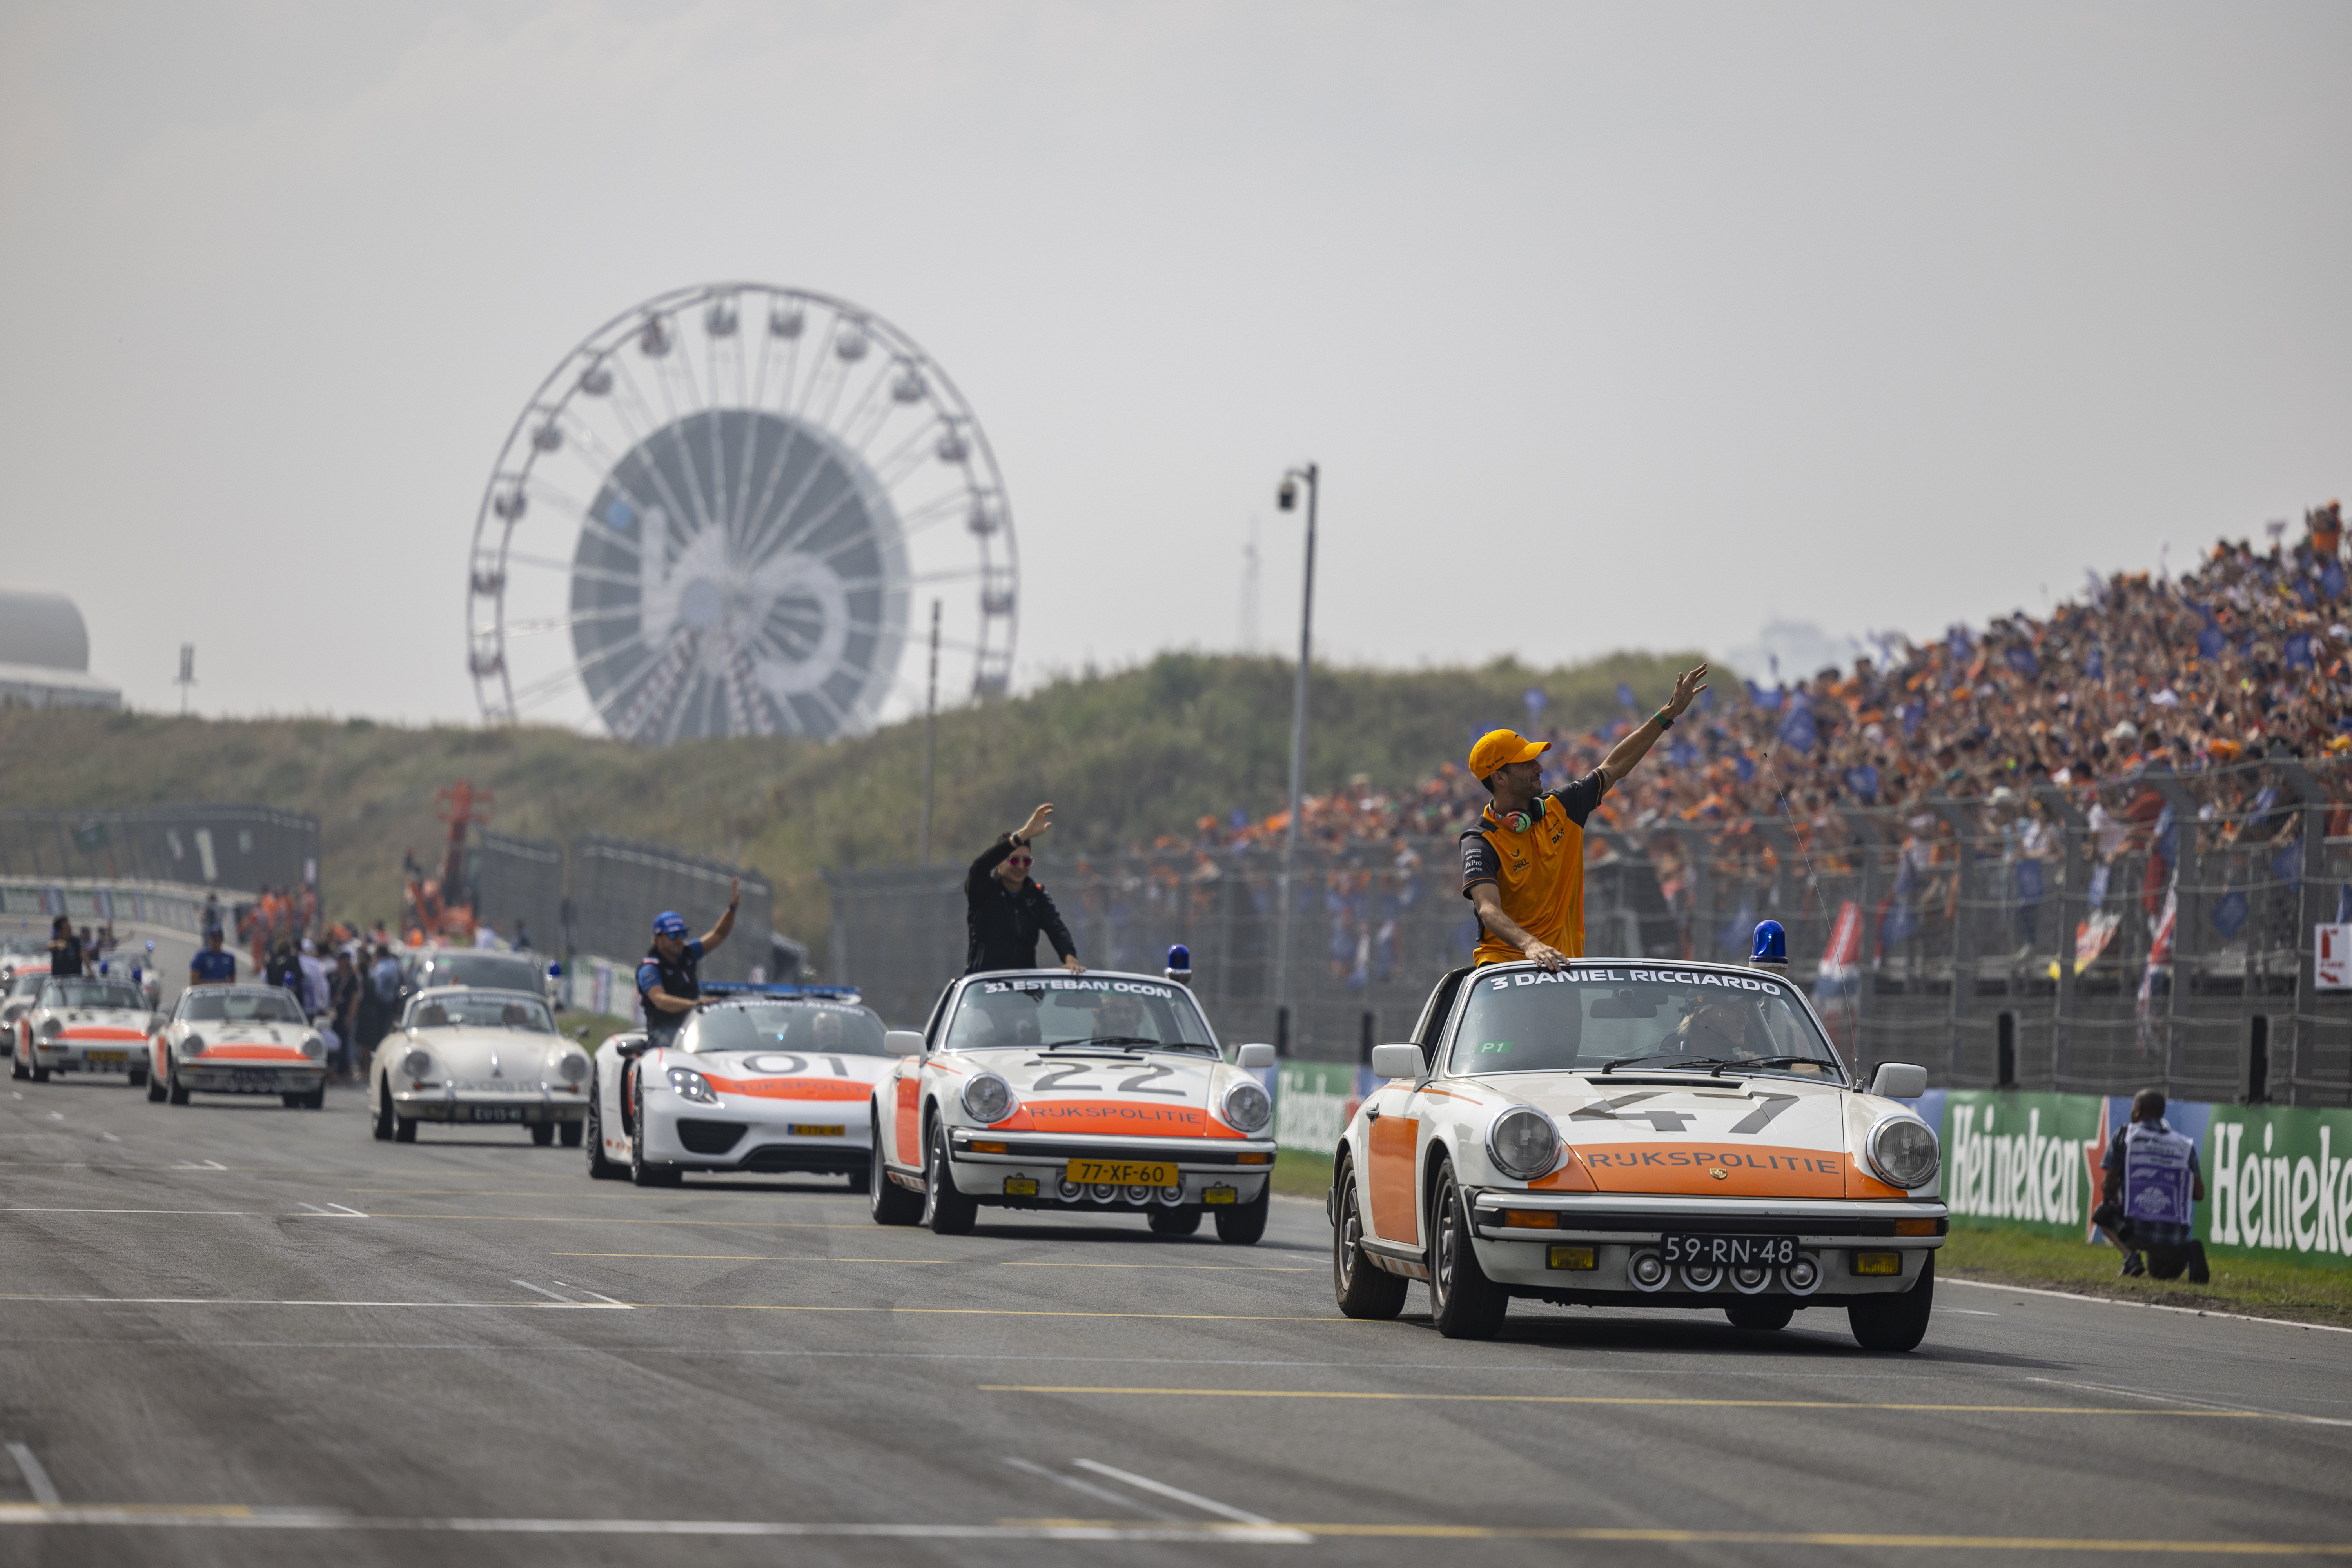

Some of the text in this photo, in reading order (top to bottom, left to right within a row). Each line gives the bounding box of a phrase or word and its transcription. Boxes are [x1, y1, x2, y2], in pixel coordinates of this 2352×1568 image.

[1466, 860, 1482, 869] FxPro
[1513, 859, 1529, 871] DELL
[985, 980, 1172, 998] 31 ESTEBAN OCON
[1490, 969, 1781, 996] 3 DANIEL RICCIARDO
[1481, 1042, 1504, 1053] P1
[743, 1054, 849, 1077] 01
[1024, 1060, 1187, 1096] 22
[1569, 1091, 1800, 1134] 47
[1081, 1163, 1164, 1182] 77-XF-60
[1947, 1103, 2080, 1226] Heineken
[1664, 1237, 1793, 1263] 59-RN-48
